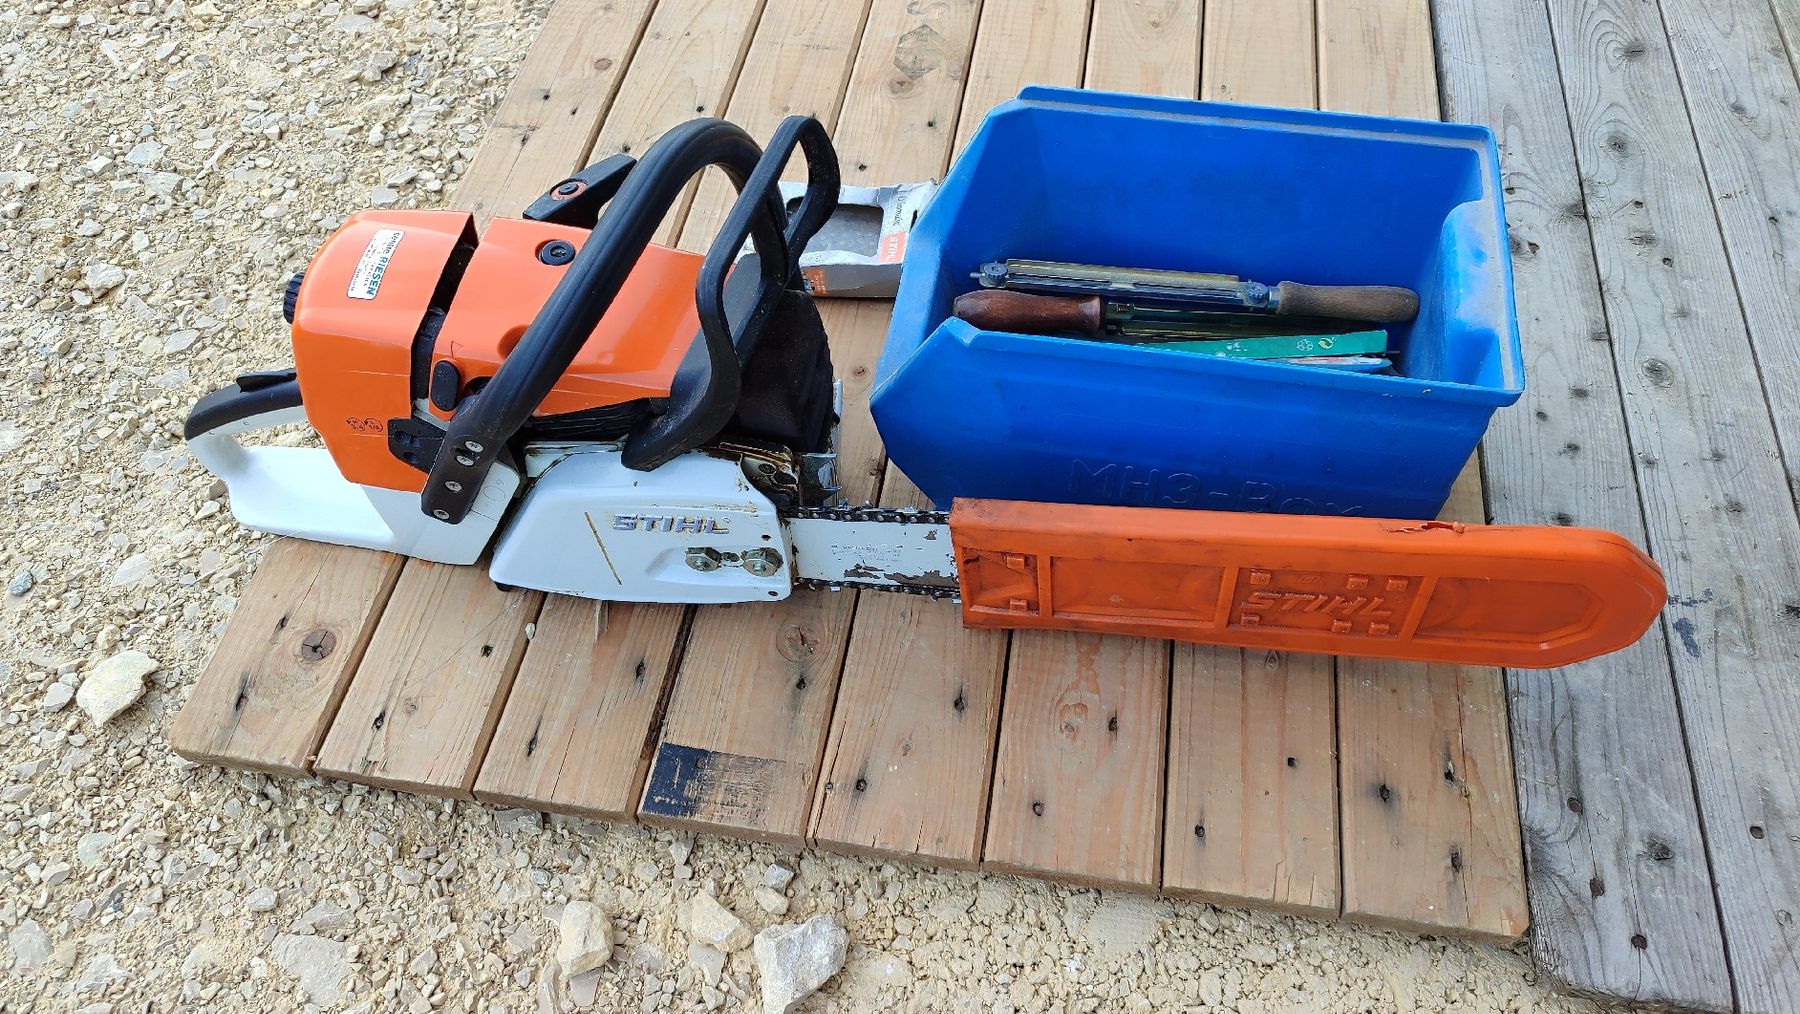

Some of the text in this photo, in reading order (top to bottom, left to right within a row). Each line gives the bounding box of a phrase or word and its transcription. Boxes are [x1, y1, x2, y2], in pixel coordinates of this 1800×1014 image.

[888, 236, 898, 261] STIHL
[366, 256, 389, 296] RIESEN
[613, 513, 730, 534] STIHL
[1240, 591, 1393, 616] STIHL
